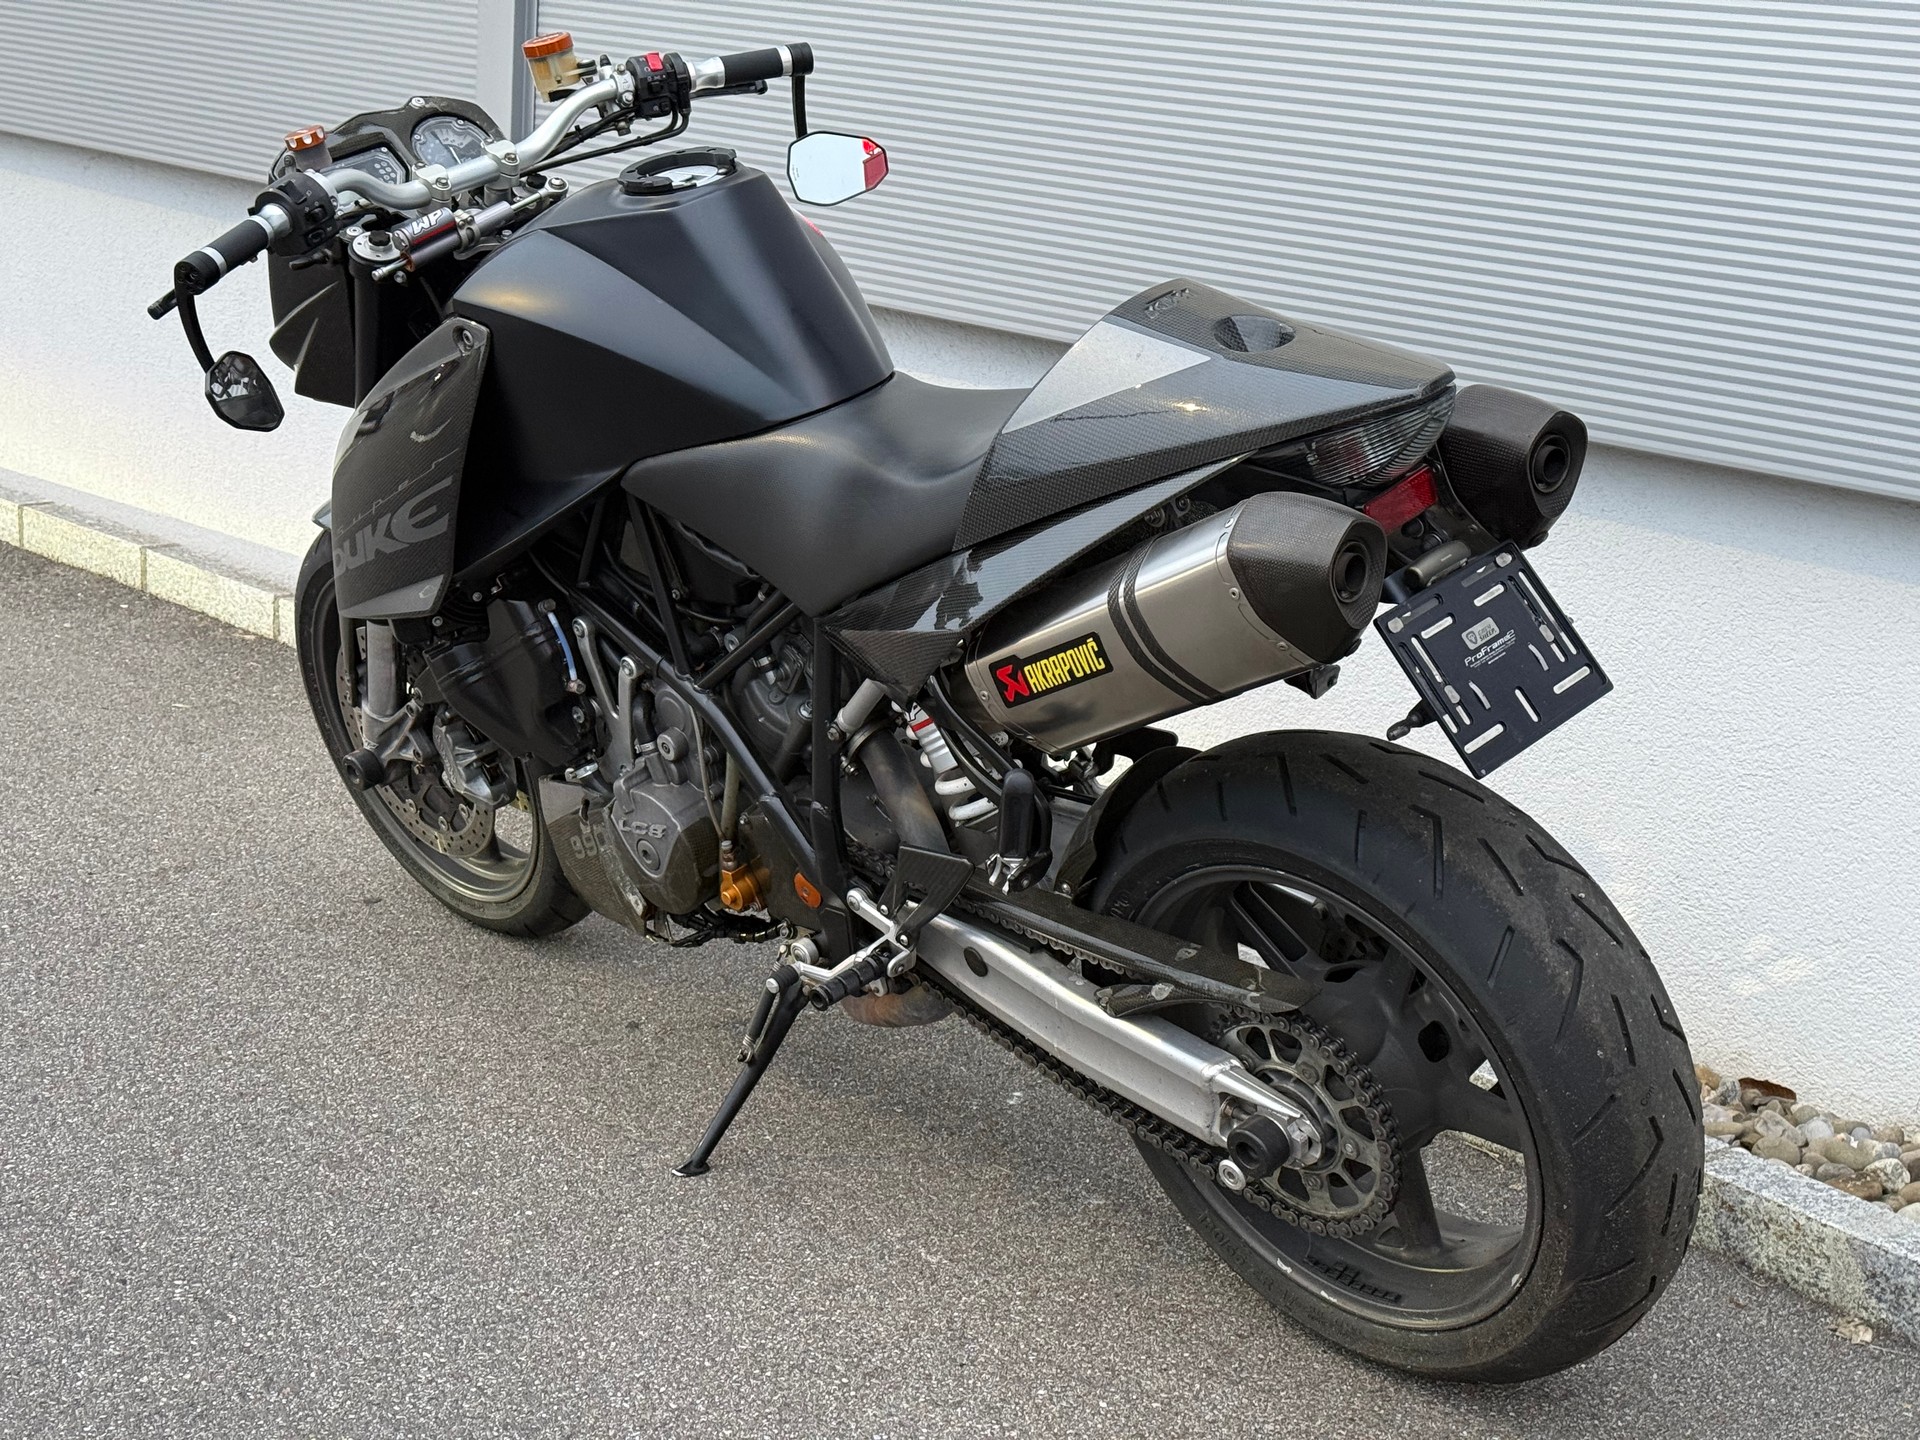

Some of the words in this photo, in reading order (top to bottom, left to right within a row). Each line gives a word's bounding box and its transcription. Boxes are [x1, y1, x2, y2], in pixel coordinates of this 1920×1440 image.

[411, 209, 443, 235] WP
[333, 474, 455, 578] DUKE
[618, 817, 667, 839] LC8
